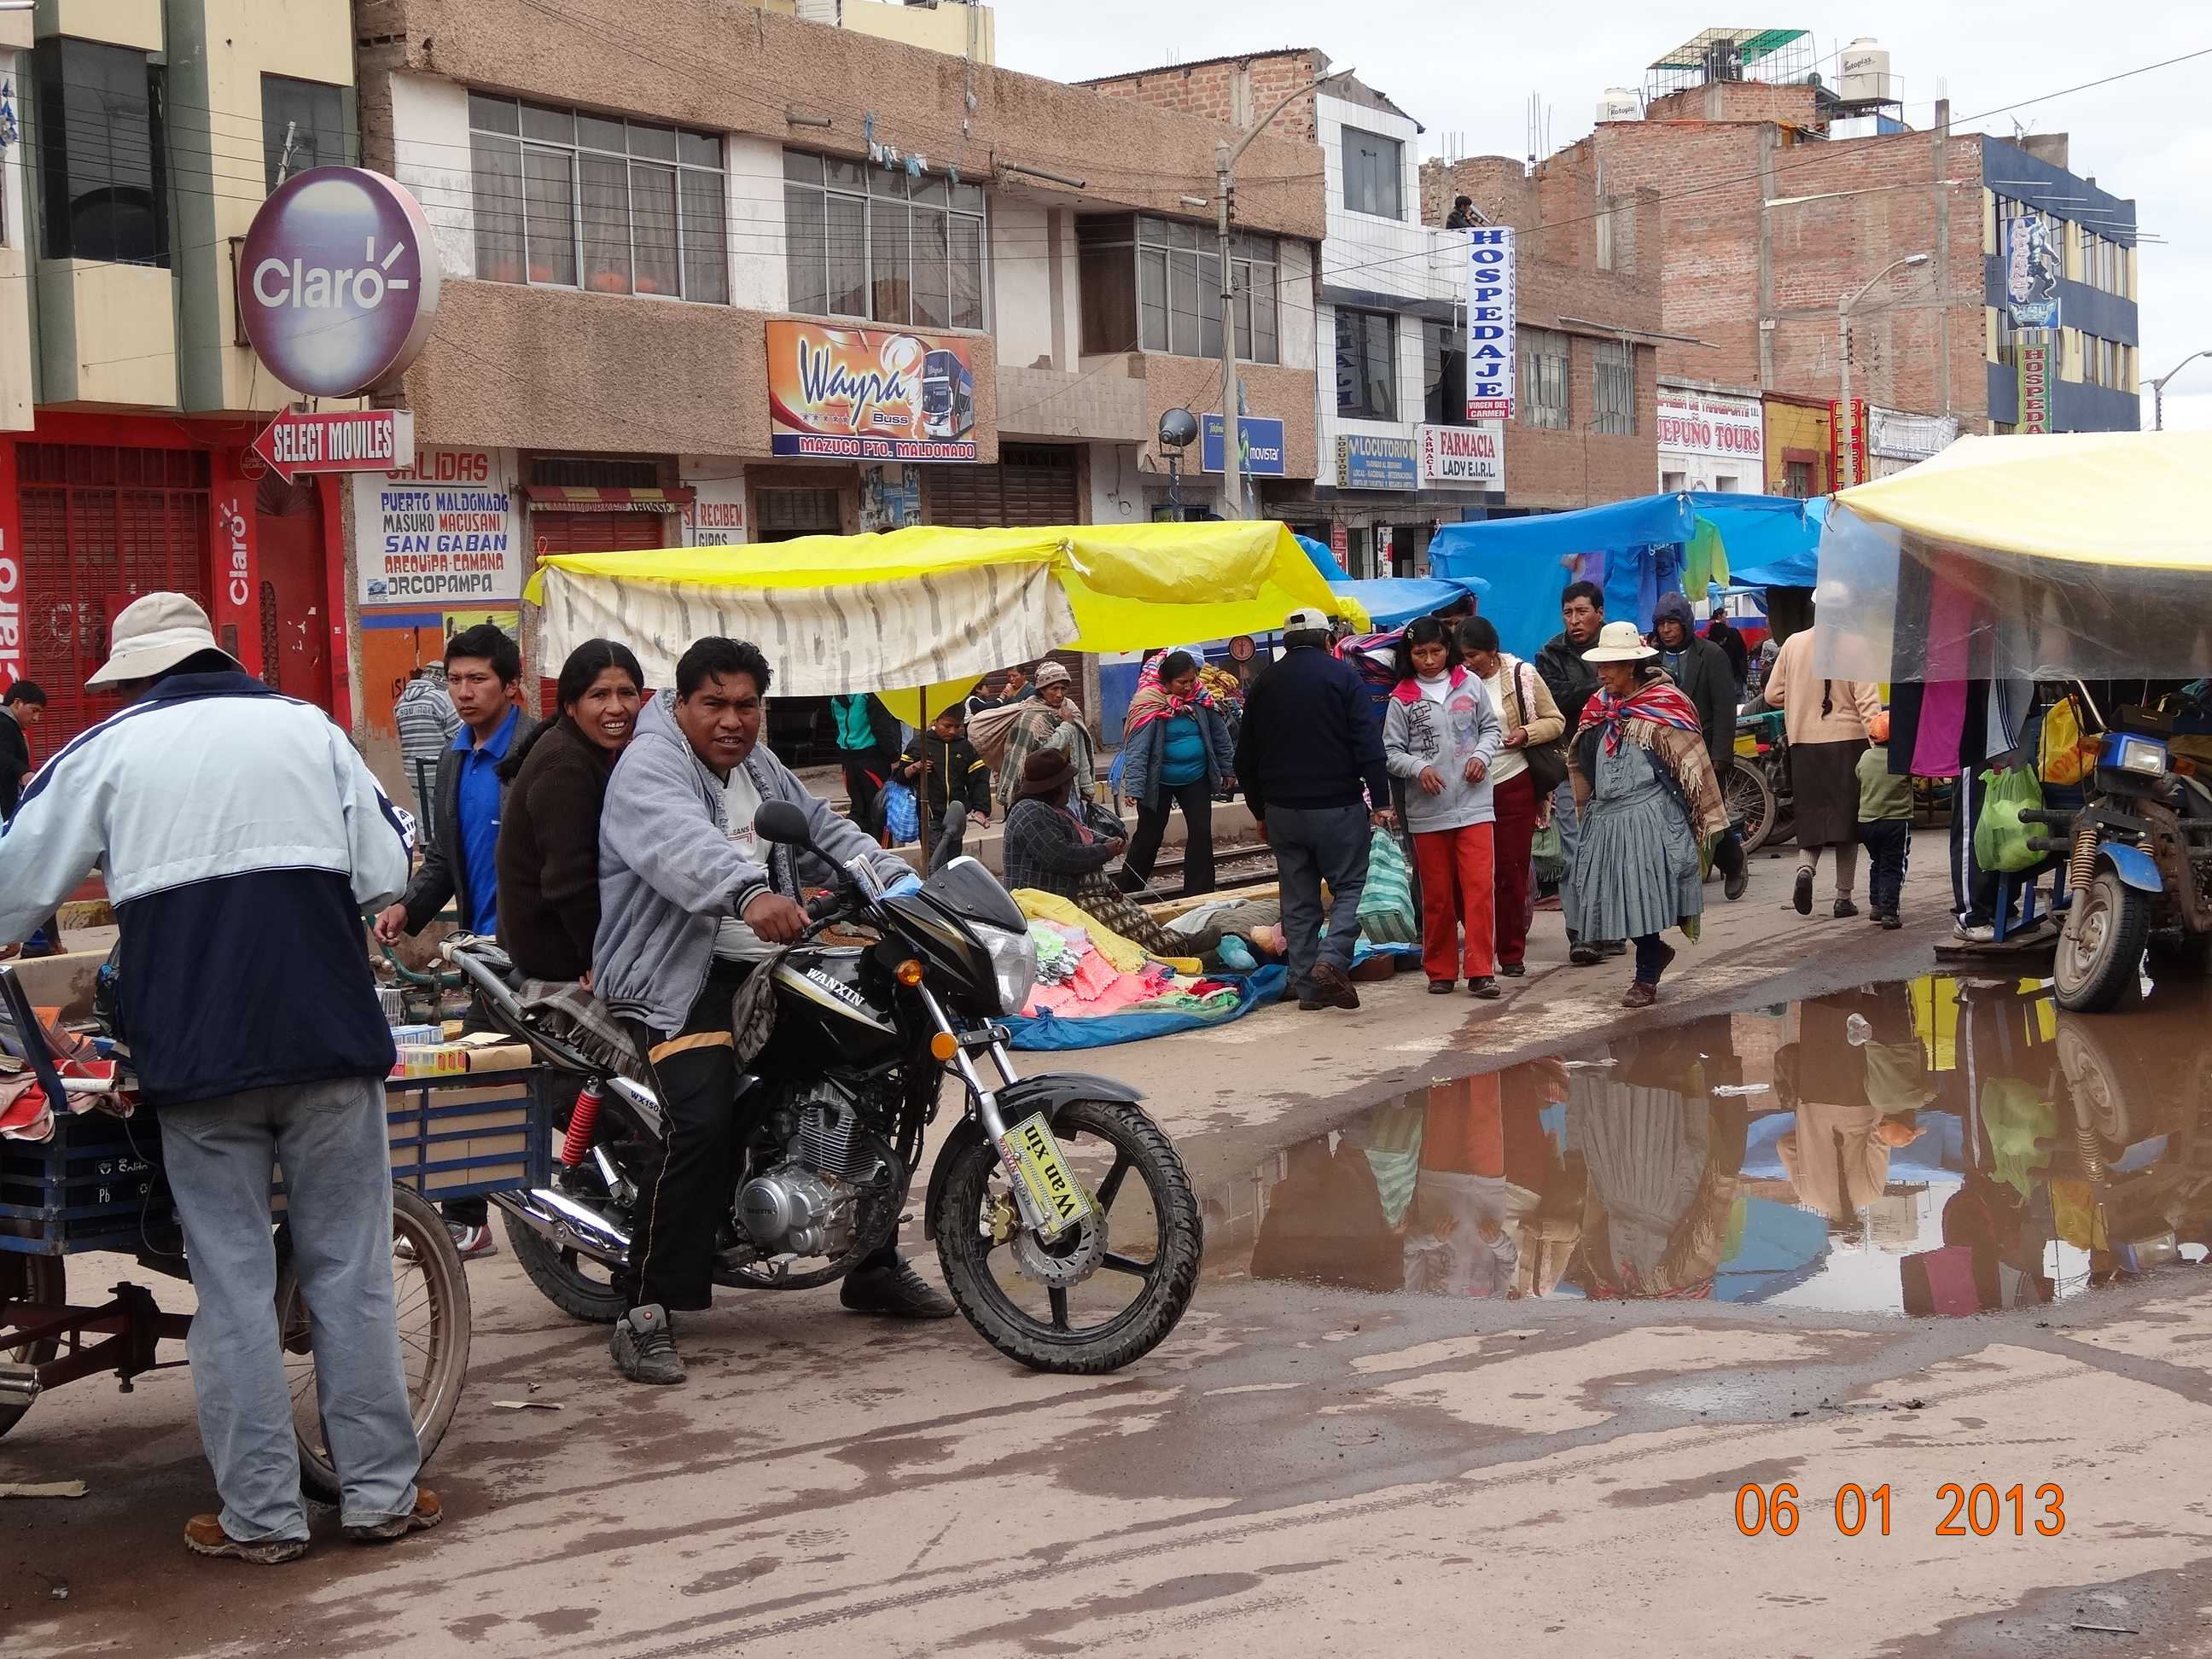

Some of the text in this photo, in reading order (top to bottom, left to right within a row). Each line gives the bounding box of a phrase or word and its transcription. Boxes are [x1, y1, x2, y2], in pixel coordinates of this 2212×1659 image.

[253, 254, 385, 311] Claro
[1471, 230, 1506, 397] HOSPEDAJE
[800, 339, 906, 426] Wayra
[2023, 348, 2046, 434] HOSPEDA
[1469, 400, 1507, 410] VIRGEN DEL
[1470, 409, 1505, 417] CARMEN
[872, 412, 909, 425] Buss
[273, 418, 393, 463] SELECT MOVILES
[800, 437, 975, 459] MAZUCO PTO. MALDONADO
[1360, 437, 1409, 459] LOCUTORIO
[1441, 431, 1495, 458] FARMACIA
[1715, 422, 1760, 454] TOURS
[1249, 446, 1280, 461] movistar
[1338, 436, 1347, 486] LOCUTORIO
[1425, 429, 1434, 476] FARMACIA
[1442, 460, 1495, 477] LADY E.I.R.L.
[381, 492, 430, 512] PUERTO
[436, 492, 509, 512] MALDONADO
[383, 513, 501, 533] MASUKO MACUSANI
[701, 503, 742, 527] RECIBEN
[385, 534, 507, 553] SAN GABAN
[698, 533, 728, 547] GIROS
[229, 515, 249, 606] Claro
[388, 573, 492, 596] ORCOPAMPA
[806, 968, 865, 1007] WANXIN
[997, 1137, 1018, 1173] WANXIN
[99, 1188, 110, 1203] Pb
